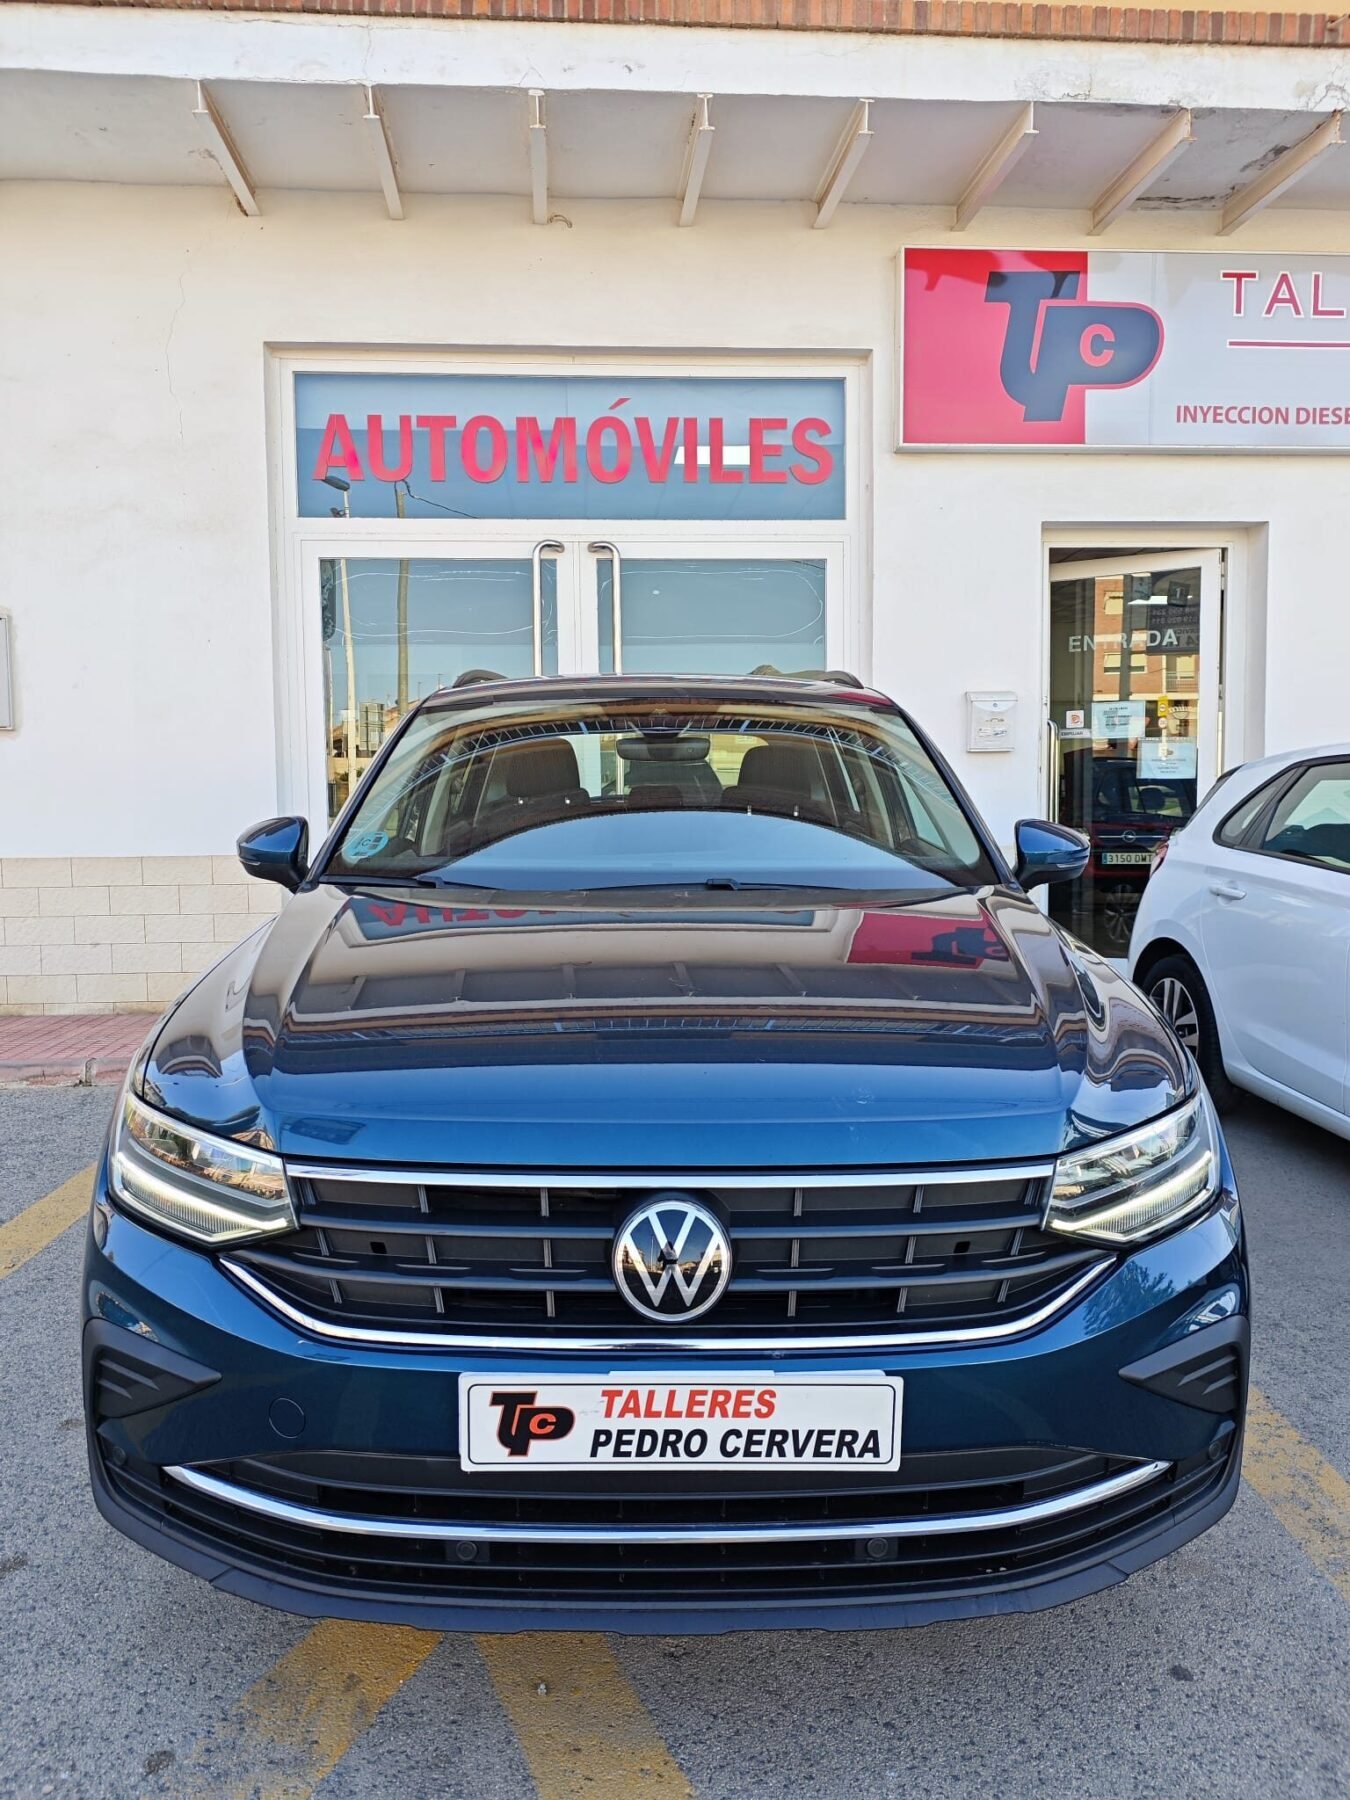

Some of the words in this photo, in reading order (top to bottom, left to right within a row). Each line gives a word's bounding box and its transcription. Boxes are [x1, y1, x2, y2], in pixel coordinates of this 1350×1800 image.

[1219, 270, 1350, 319] TAL
[1176, 404, 1289, 425] INYECCION
[312, 397, 834, 484] AUTOMÓVILES
[1068, 628, 1178, 653] ENTRADA
[1108, 854, 1131, 863] 3150
[600, 1389, 777, 1419] TALLERES
[590, 1428, 708, 1458] PEDRO
[719, 1429, 881, 1458] CERVERA
